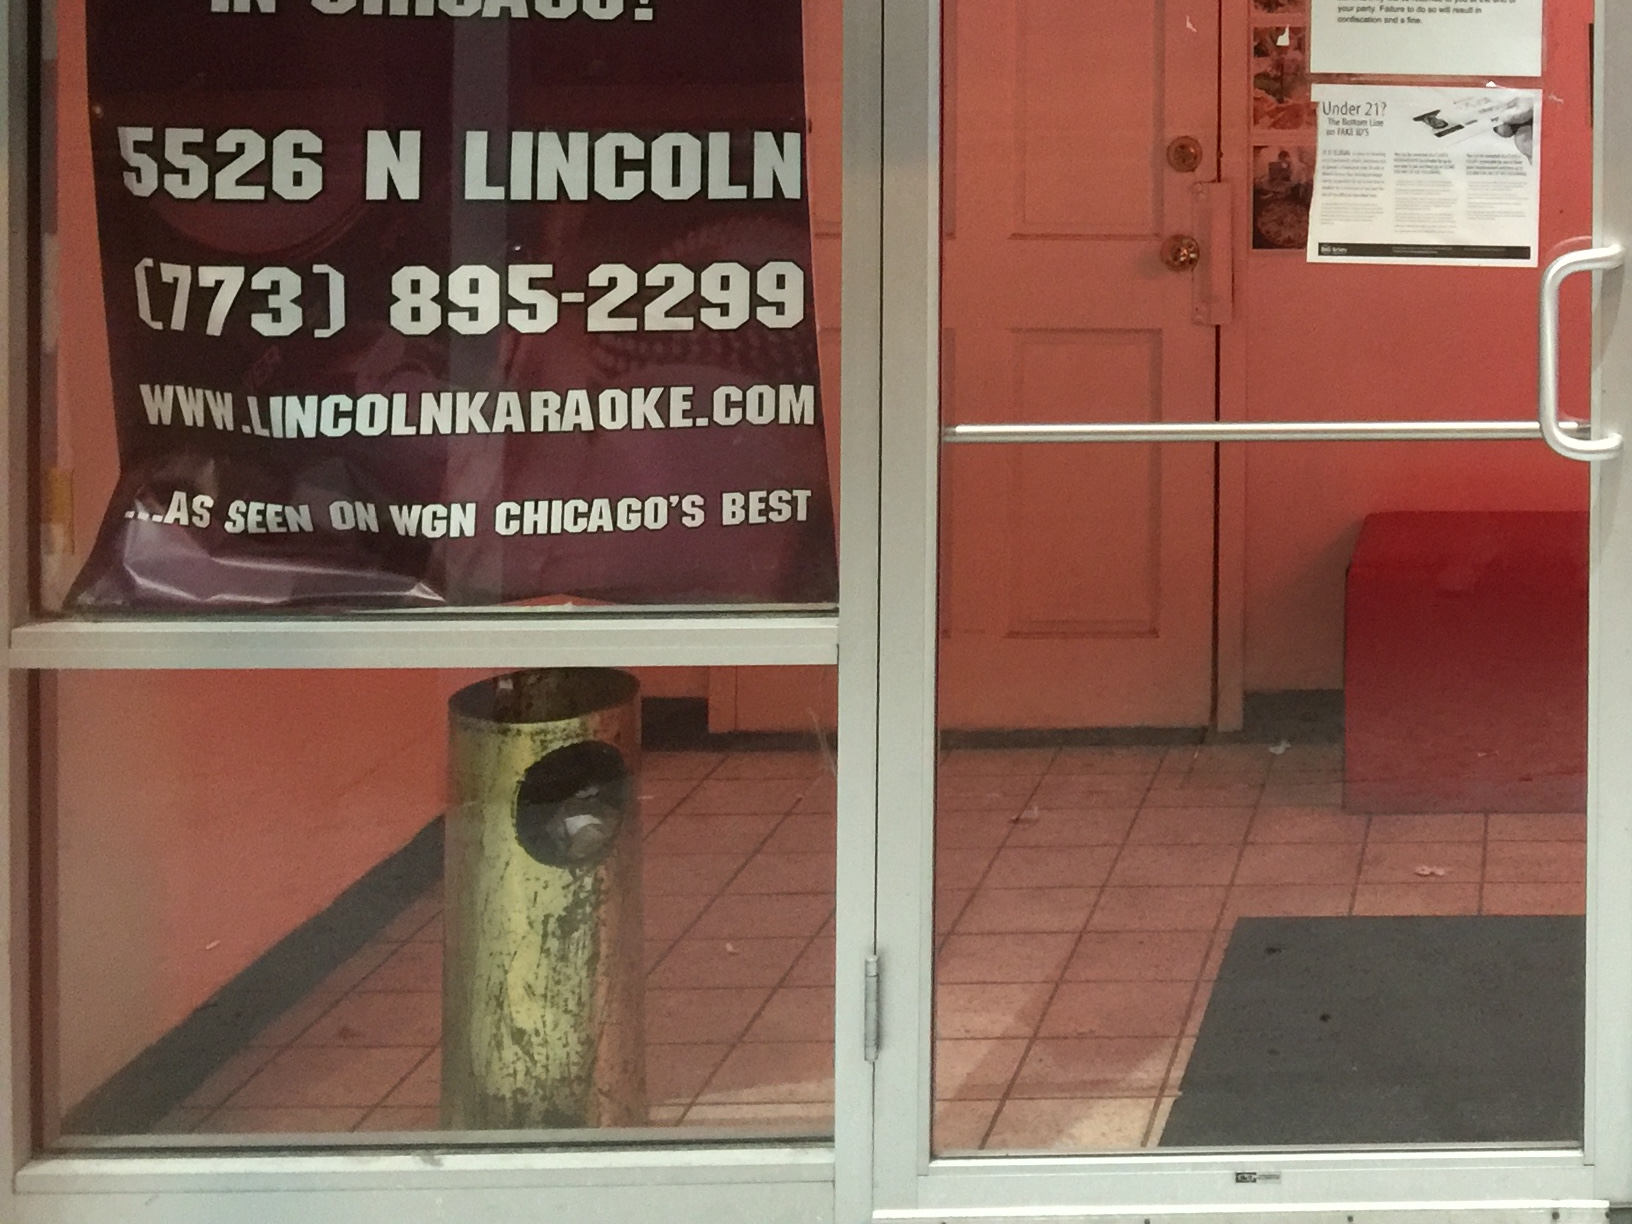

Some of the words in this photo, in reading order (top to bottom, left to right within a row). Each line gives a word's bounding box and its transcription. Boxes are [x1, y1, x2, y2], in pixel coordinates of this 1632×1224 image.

[1322, 101, 1361, 115] Under
[1365, 102, 1387, 116] 21?
[118, 125, 324, 202] 5526
[365, 130, 422, 201] N
[464, 130, 801, 201] LINCOLN
[134, 257, 346, 338] (773)
[390, 260, 804, 336] 895-2299
[139, 384, 816, 438] WWW.LINCOLNKARAOKE.COM
[224, 498, 314, 534] SEEN
[329, 500, 379, 533] ON
[391, 502, 477, 538] WGN
[495, 494, 705, 537] CHICAGO'S
[722, 488, 812, 526] BEST
